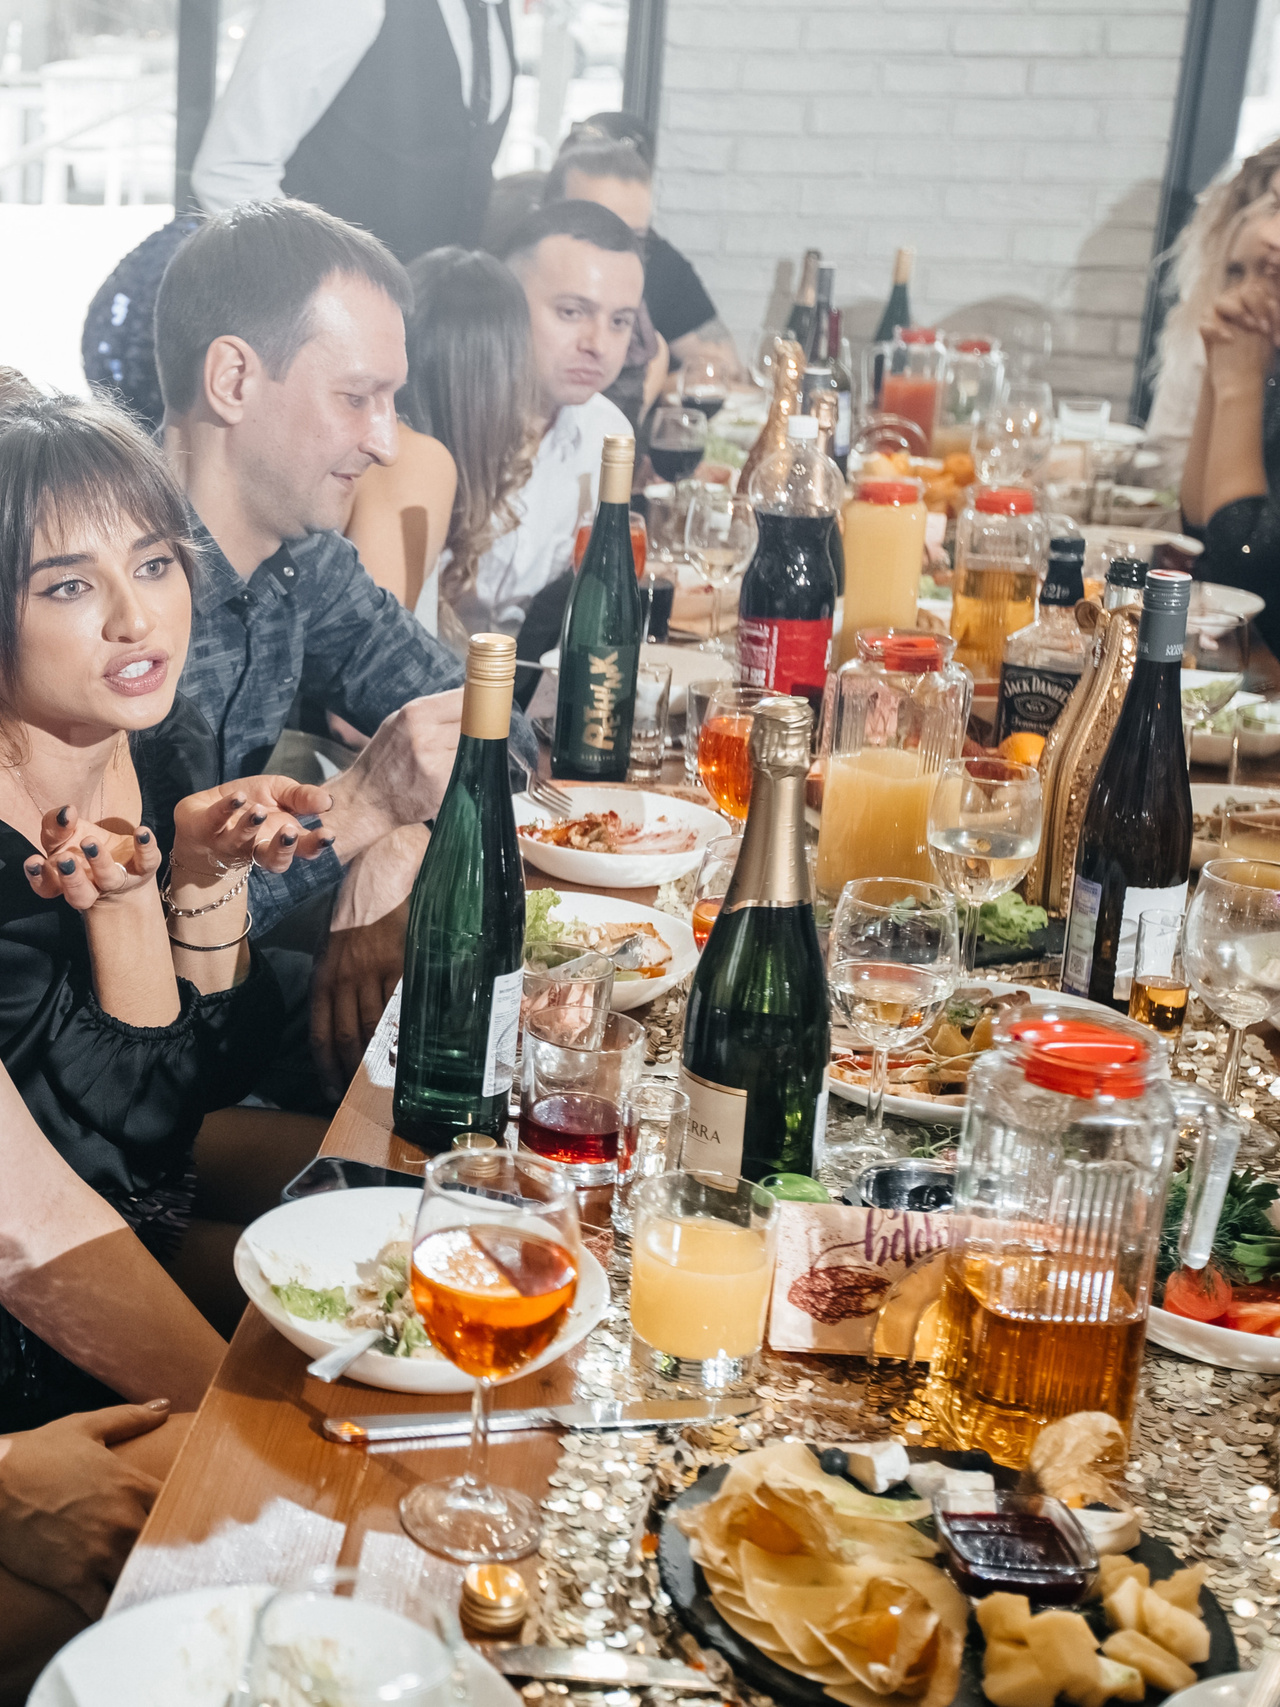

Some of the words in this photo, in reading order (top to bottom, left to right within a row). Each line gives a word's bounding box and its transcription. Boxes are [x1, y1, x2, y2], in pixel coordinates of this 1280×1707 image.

[1004, 678, 1031, 699] JACK
[681, 1115, 721, 1145] ERRA
[865, 1208, 968, 1268] appy
